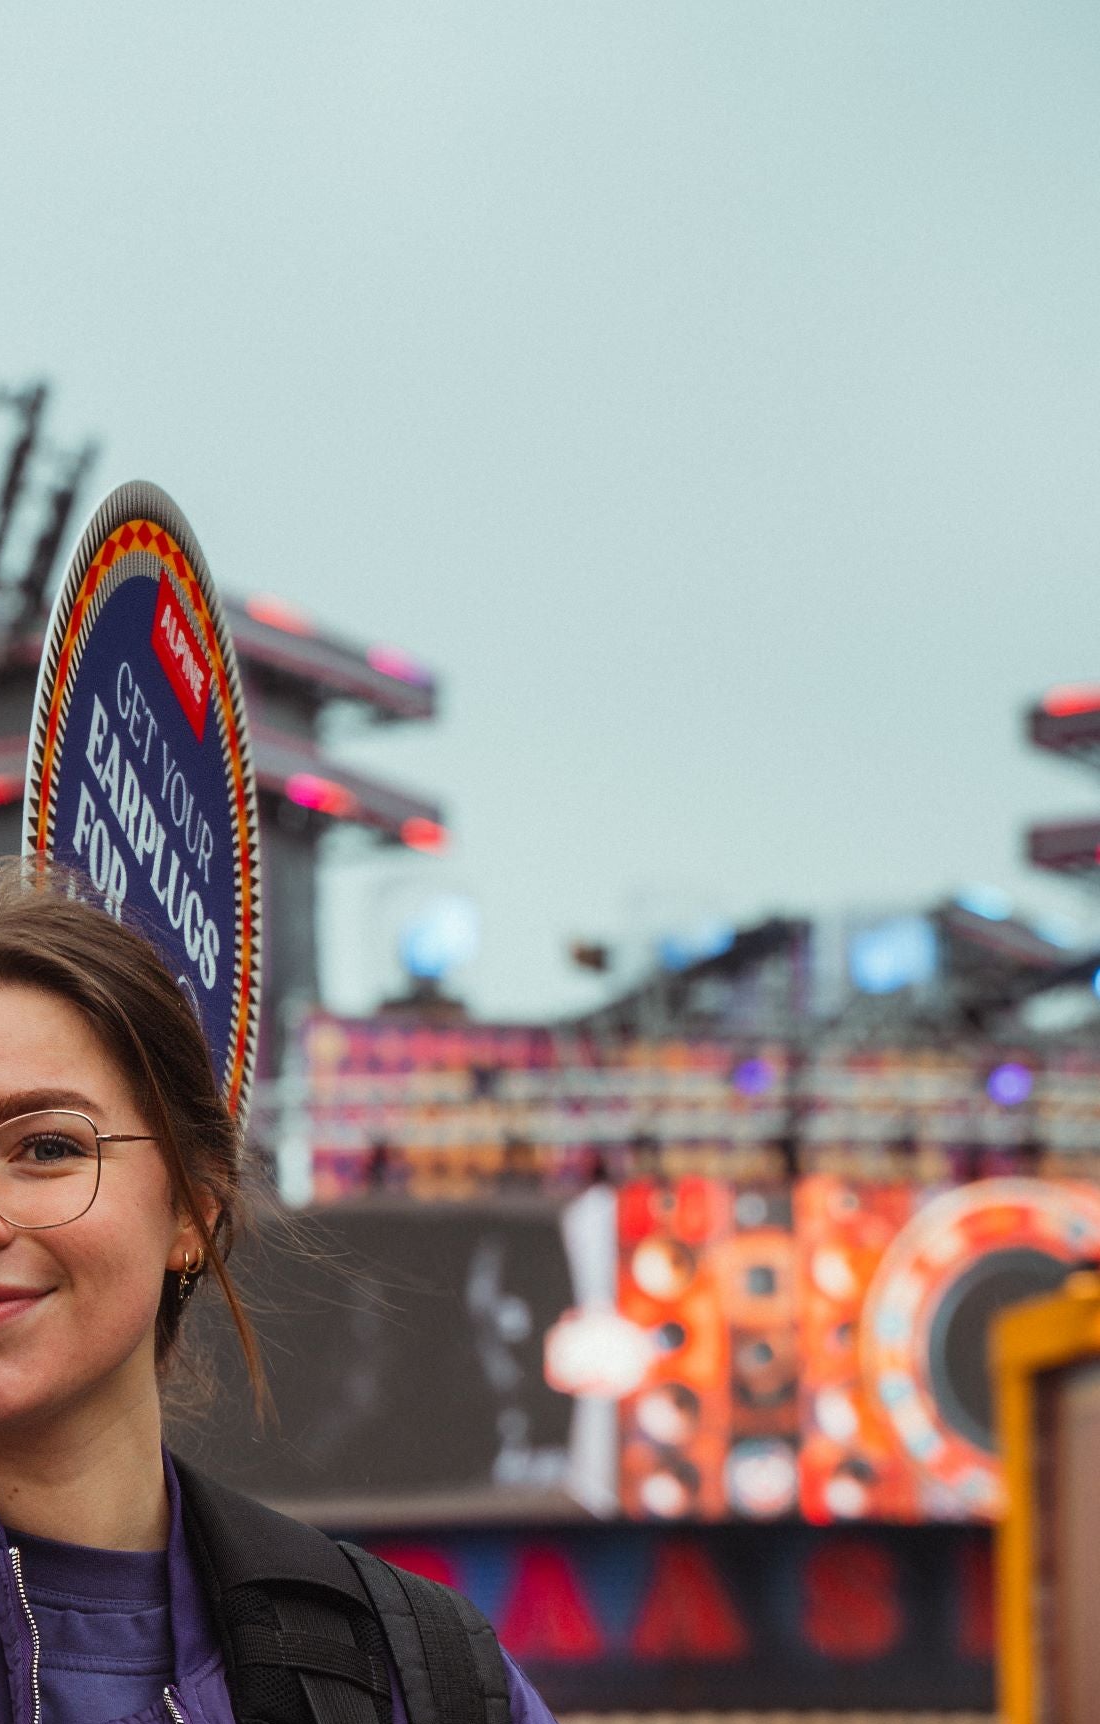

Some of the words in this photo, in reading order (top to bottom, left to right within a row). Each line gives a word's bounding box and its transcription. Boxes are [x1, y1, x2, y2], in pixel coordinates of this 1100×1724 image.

[160, 604, 205, 704] ALPINE
[73, 781, 127, 924] FOR
[86, 693, 220, 989] EARPLUGS
[117, 662, 158, 764] GET
[160, 740, 213, 884] YOUR
